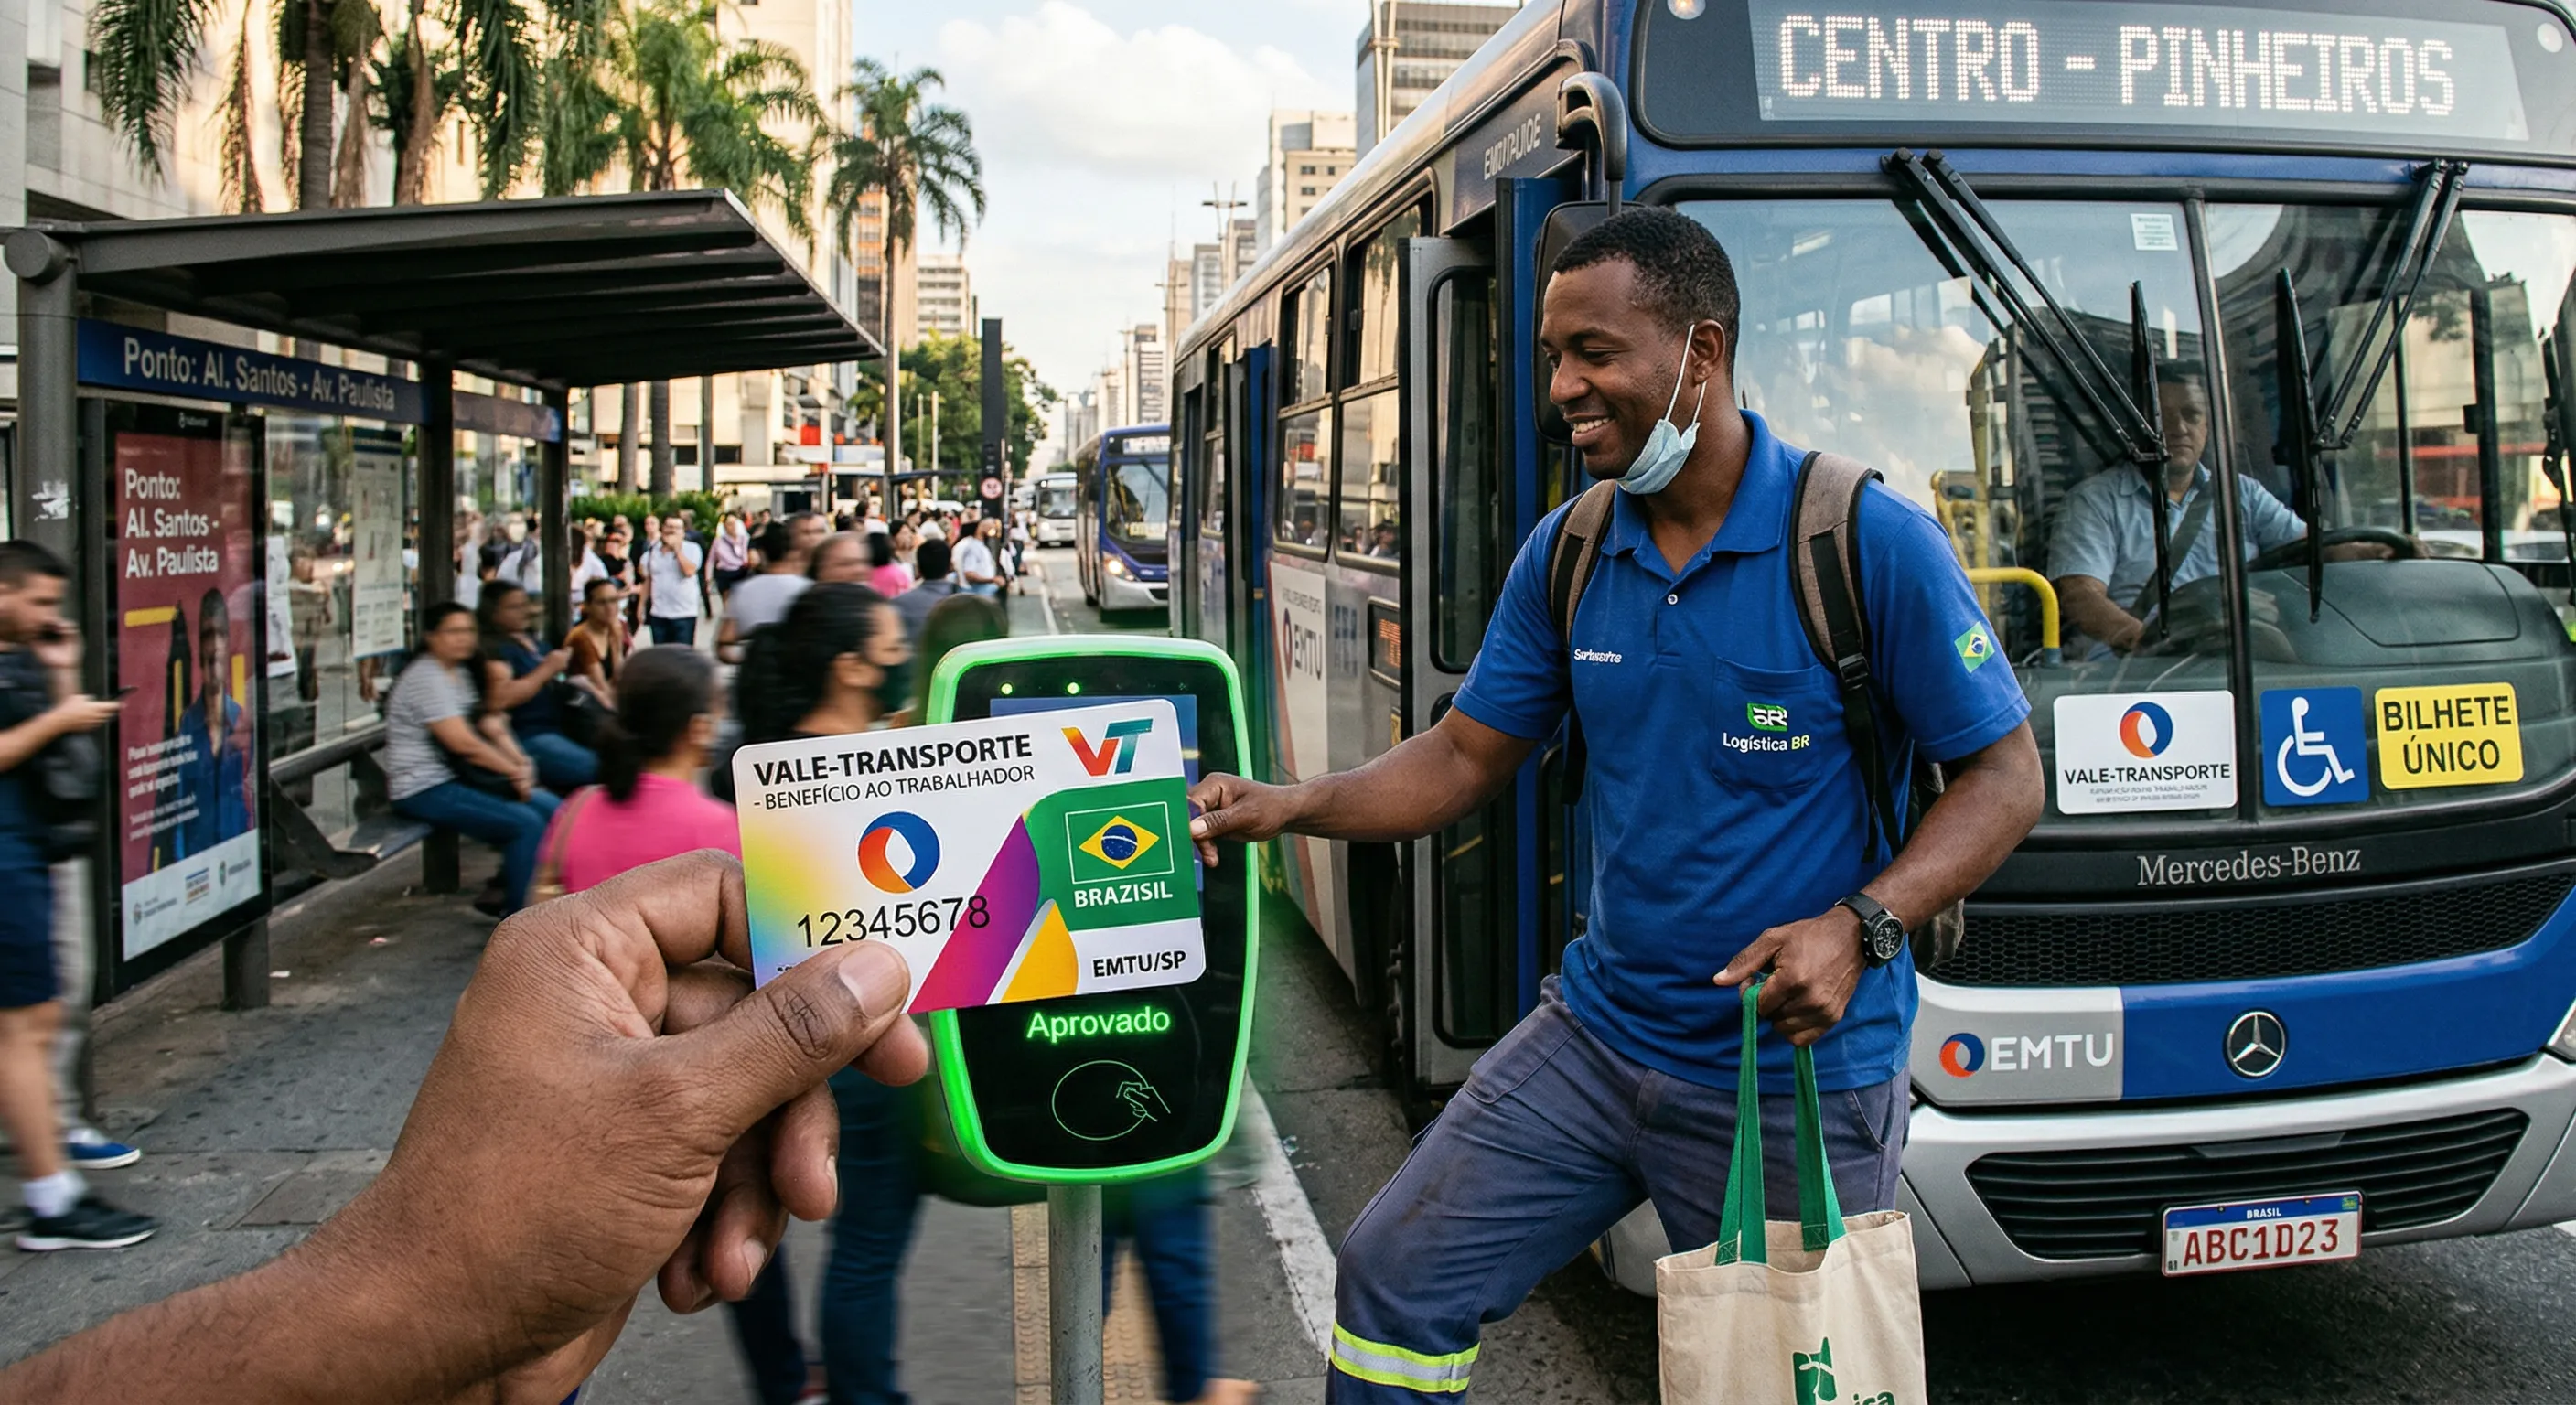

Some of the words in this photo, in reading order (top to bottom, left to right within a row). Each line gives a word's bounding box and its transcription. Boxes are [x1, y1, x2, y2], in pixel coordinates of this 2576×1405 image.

[1778, 14, 2040, 101] CENTRO
[2064, 56, 2097, 71] -
[2119, 26, 2455, 117] PINHEIROS
[124, 337, 197, 385] Ponto:
[203, 351, 230, 390] Al.
[235, 356, 297, 397] Santos
[311, 370, 336, 403] Av.
[338, 373, 395, 412] Paulista
[124, 468, 181, 499] Ponto:
[125, 508, 150, 539] Al.
[154, 507, 208, 538] Santos
[125, 549, 153, 579] Av.
[157, 545, 219, 576] Paulista
[1293, 623, 1323, 681] EMTU
[2384, 695, 2512, 731] BILHETE
[753, 734, 1033, 787] VALE-TRANSPORTE
[1061, 718, 1153, 777] VT
[1723, 732, 1787, 754] Logística
[1791, 735, 1809, 750] BR
[2403, 735, 2500, 775] ÚNICO
[764, 785, 862, 810] BENEFÍCIO
[864, 780, 893, 799] AO
[896, 765, 1035, 795] TRABALHADOR
[2065, 764, 2231, 785] VALE-TRANSPORTE
[2137, 846, 2361, 886] Mercedes-Benz
[1074, 881, 1173, 908] BRAZISIL
[797, 895, 991, 949] 12345678
[1092, 950, 1186, 978] EMTU/SP
[1026, 1007, 1170, 1044] Aprovado
[1991, 1033, 2113, 1071] EMTU
[2246, 1207, 2281, 1219] BRASIL
[2184, 1218, 2339, 1267] ABC1D23
